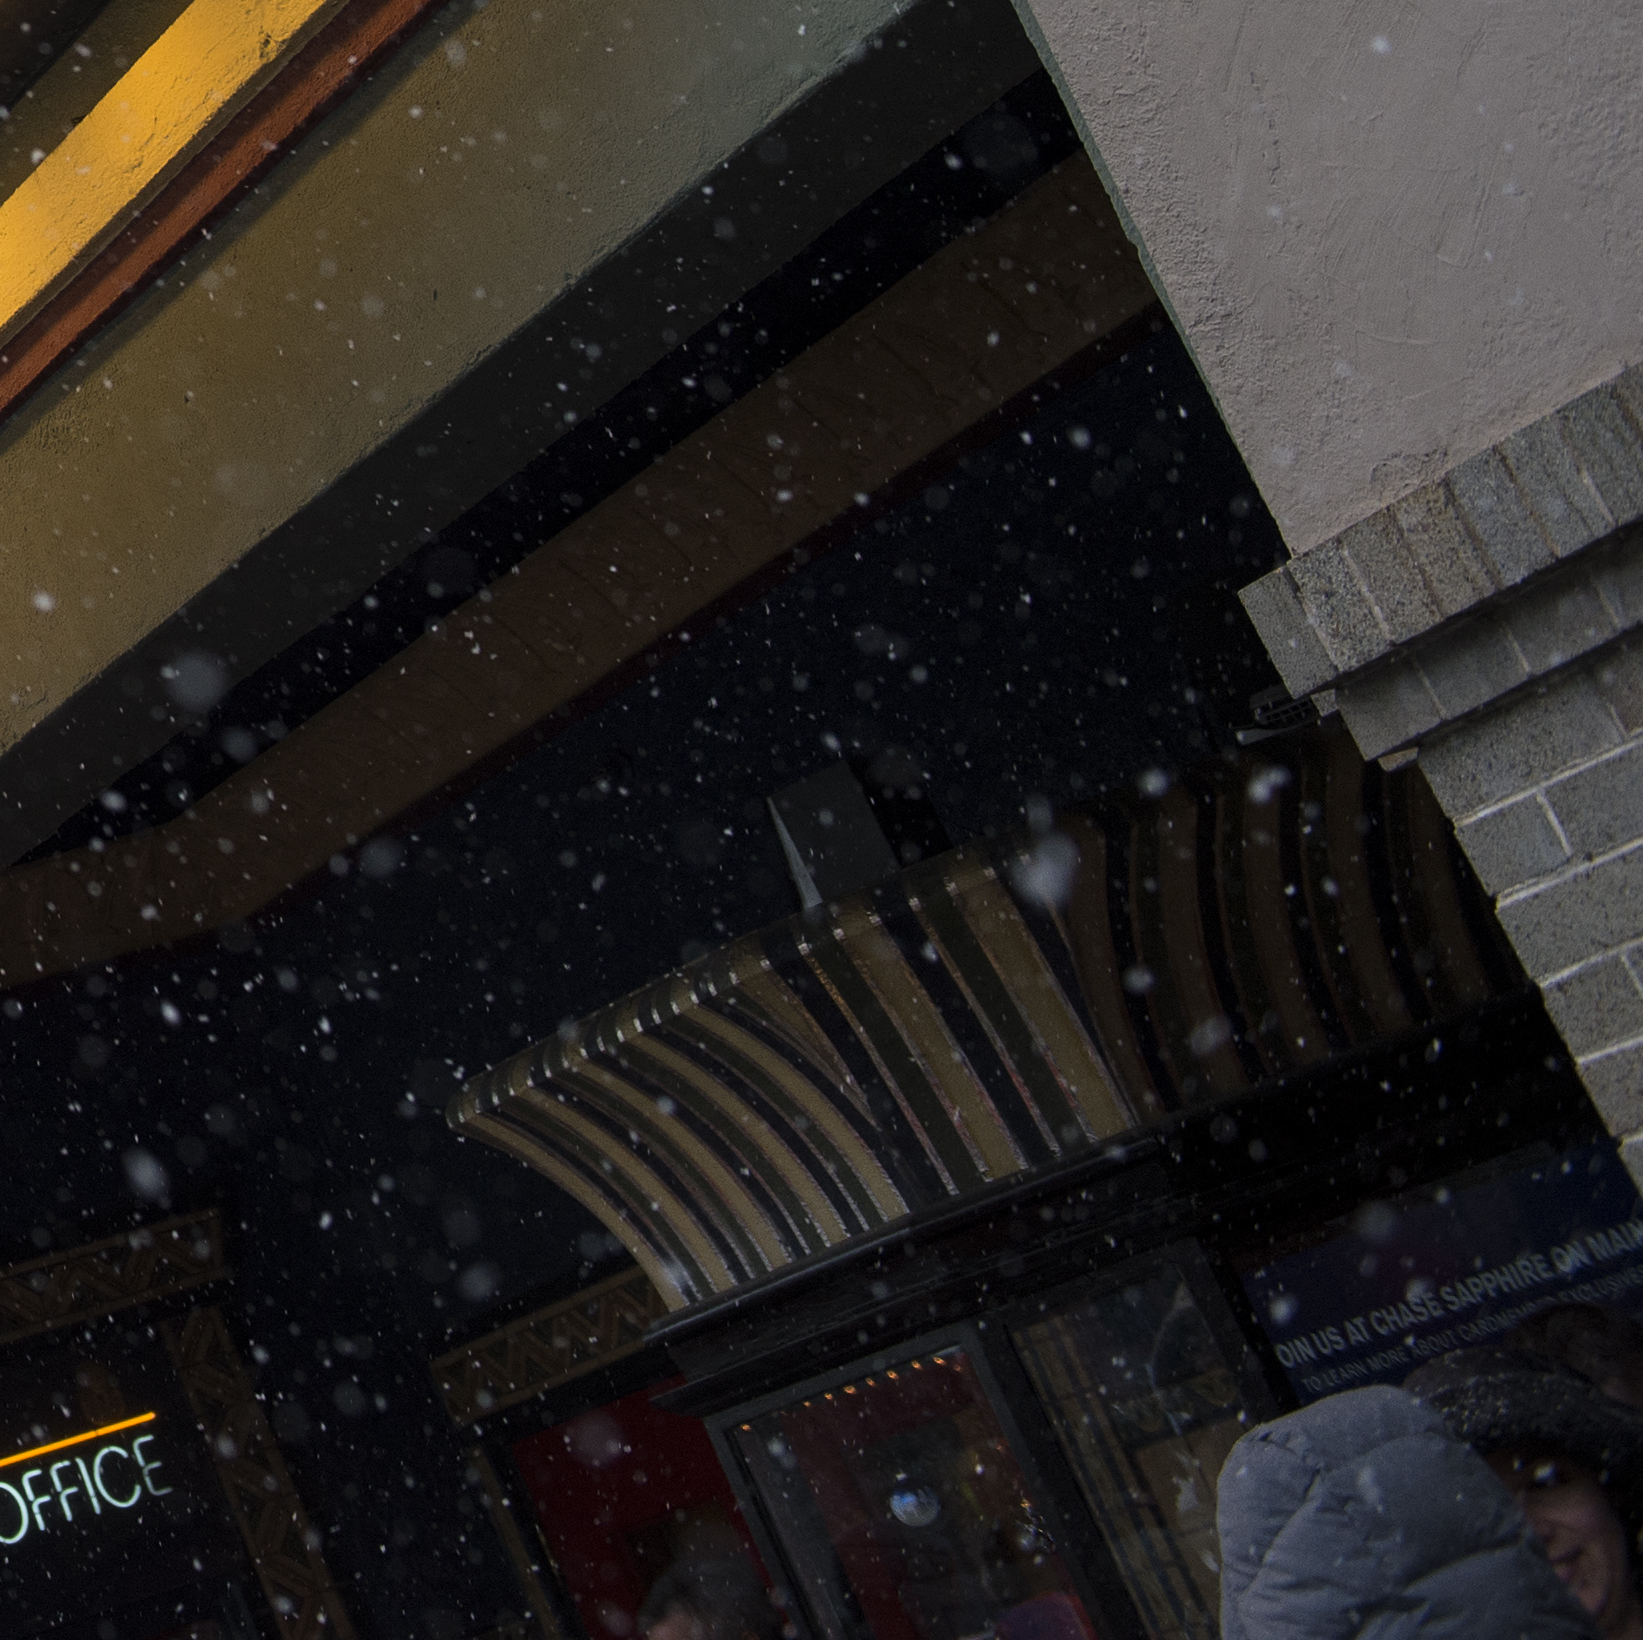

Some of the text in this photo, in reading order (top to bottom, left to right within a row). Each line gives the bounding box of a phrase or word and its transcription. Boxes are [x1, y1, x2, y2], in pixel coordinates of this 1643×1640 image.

[1311, 1324, 1347, 1357] US
[1343, 1315, 1375, 1346] AT
[1368, 1291, 1446, 1337] CHASE
[1439, 1253, 1556, 1311] SAPPHIRE
[1550, 1240, 1595, 1273] ON
[1300, 1373, 1324, 1395] TO
[1323, 1359, 1370, 1388] LEARN
[1365, 1346, 1412, 1373] MORE
[1410, 1328, 1461, 1359] ABOUT
